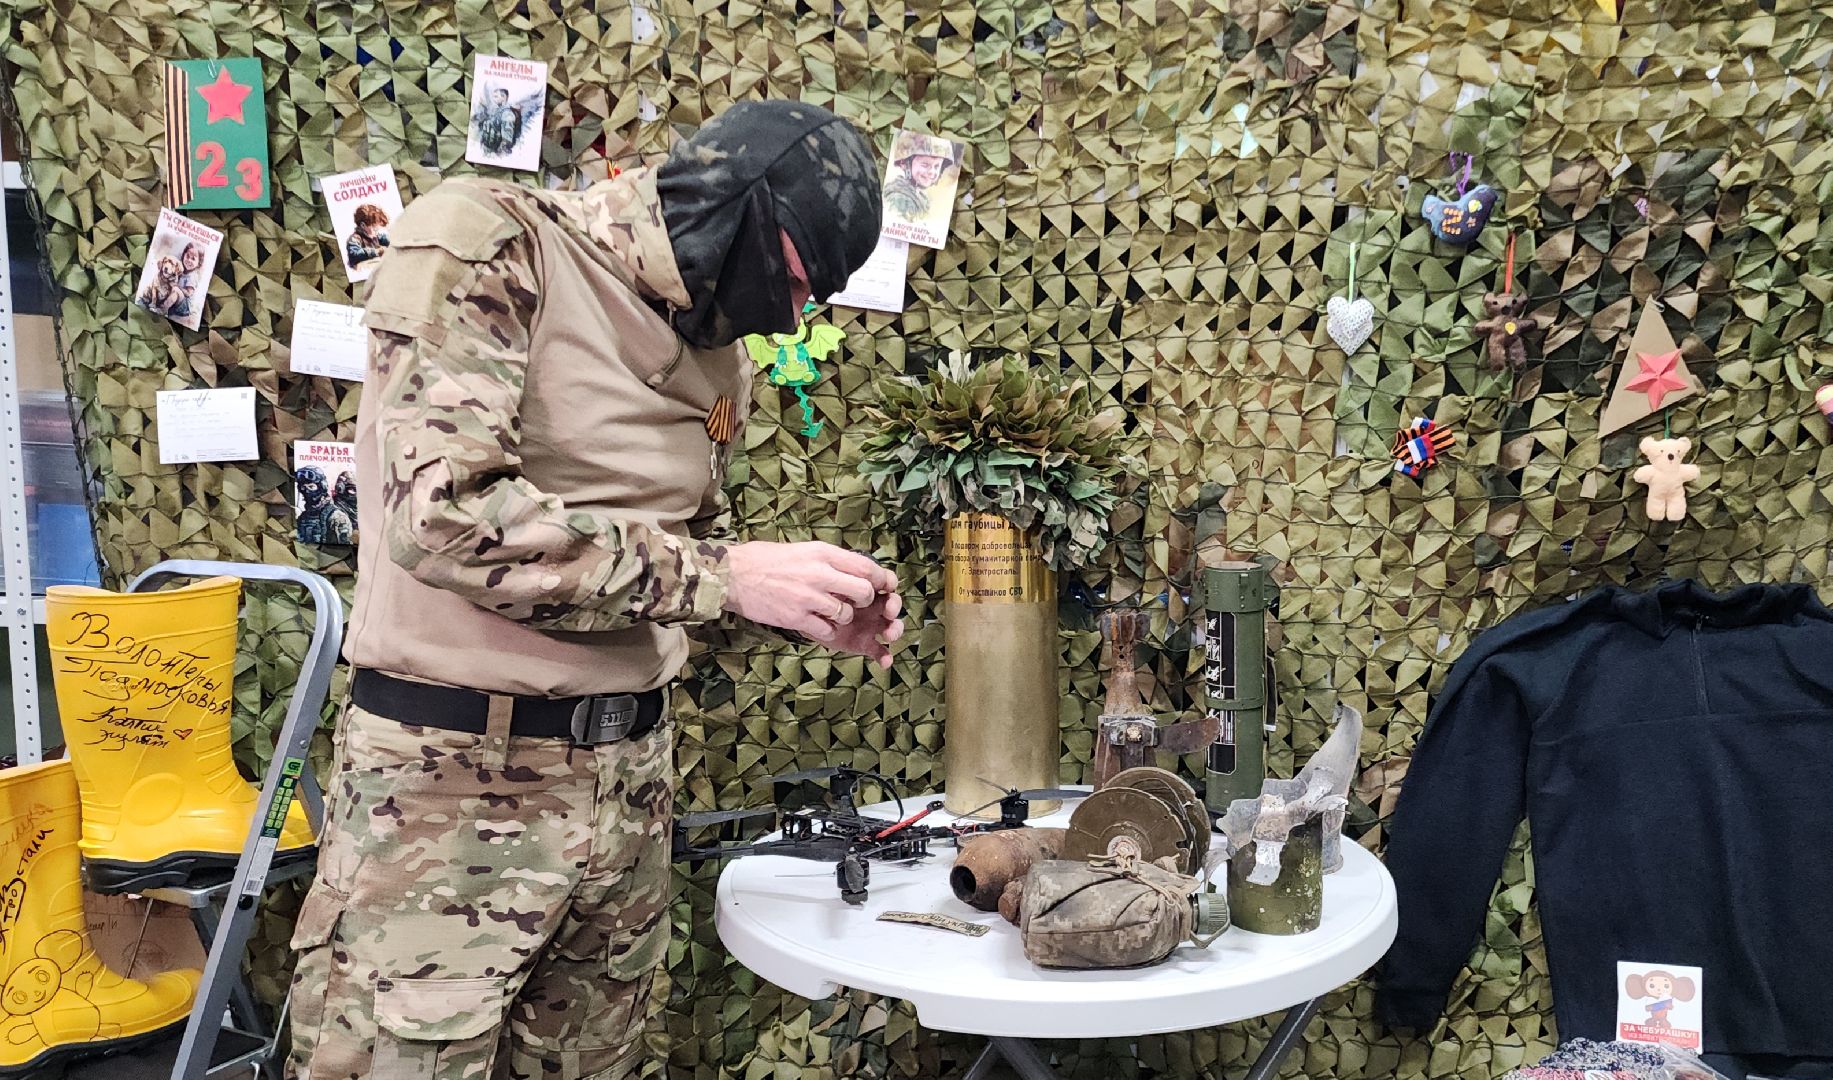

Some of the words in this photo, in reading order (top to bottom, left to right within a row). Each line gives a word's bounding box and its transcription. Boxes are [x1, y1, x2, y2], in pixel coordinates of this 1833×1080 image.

[490, 60, 533, 76] АНГЕЛЫ
[339, 174, 377, 190] ЛУЧШЕМУ
[333, 180, 388, 202] СОЛДАТУ
[910, 232, 927, 242] КАК
[928, 236, 940, 244] ТЫ
[310, 445, 349, 456] БРАТЬЯ
[299, 454, 329, 462] ПЛЕЧОМ
[337, 456, 356, 464] ПЛЕЧ
[964, 519, 1005, 532] гаубицы
[966, 588, 1007, 598] участников
[1009, 586, 1023, 597] СВО
[1623, 1023, 1636, 1032] ЗА
[1637, 1025, 1697, 1040] ЧЕБУРАШКУ!
